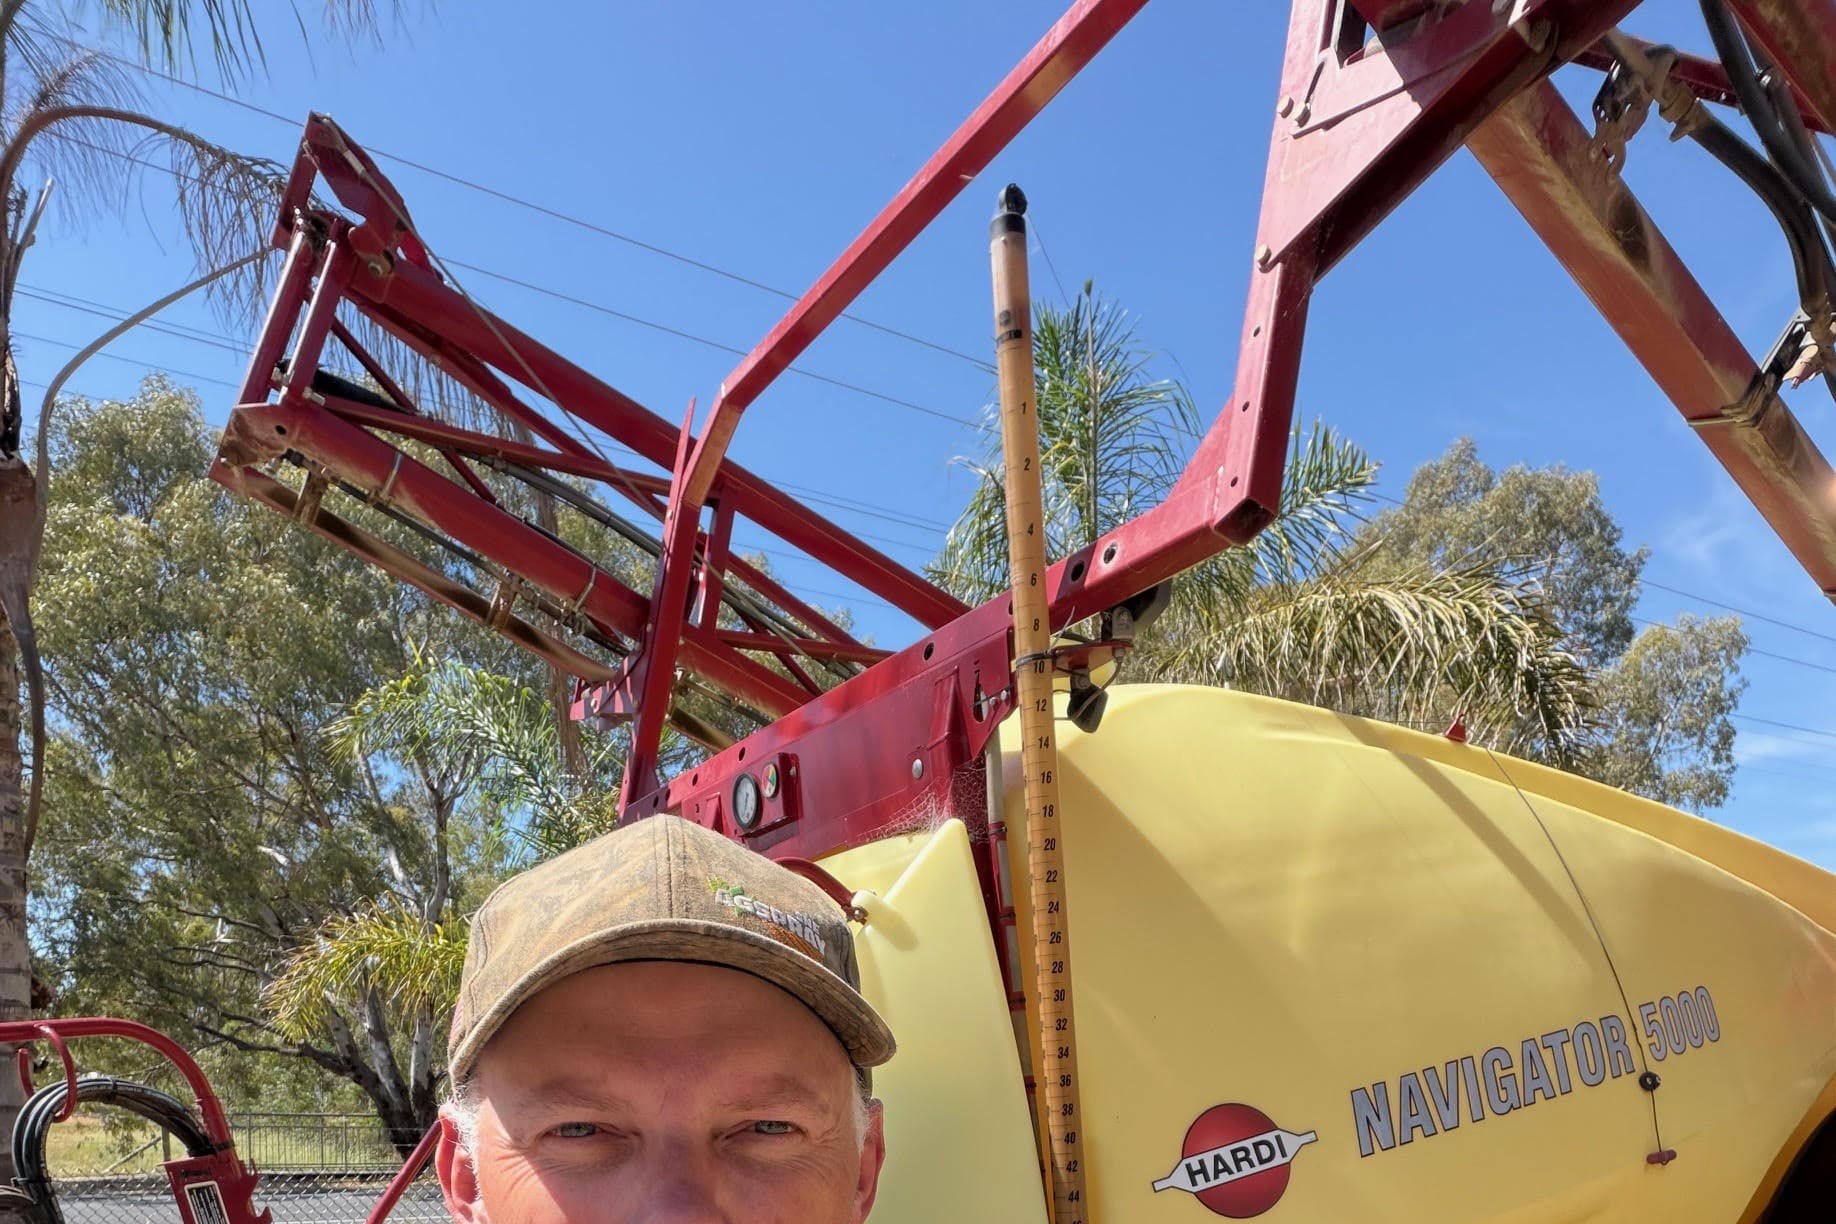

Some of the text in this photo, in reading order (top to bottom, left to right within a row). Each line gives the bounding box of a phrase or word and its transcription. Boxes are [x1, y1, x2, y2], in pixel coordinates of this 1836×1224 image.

[1034, 660, 1045, 673] 10
[1036, 699, 1046, 712] 12
[1038, 736, 1049, 749] 14
[1041, 771, 1052, 784] 16
[1042, 804, 1054, 817] 18
[1044, 838, 1056, 850] 20
[1046, 870, 1058, 883] 22
[1048, 901, 1059, 914] 24
[1050, 932, 1061, 944] 26
[1052, 961, 1063, 974] 28
[1054, 989, 1065, 1001] 30
[1055, 1018, 1067, 1031] 32
[1058, 1046, 1069, 1059] 34
[1351, 986, 1720, 1157] NAVIGATOR 5000
[1060, 1074, 1071, 1087] 36
[1062, 1104, 1073, 1116] 38
[1064, 1132, 1076, 1144] 40
[1066, 1160, 1078, 1172] 42
[1185, 1134, 1288, 1187] HARDI
[1068, 1190, 1080, 1202] 44
